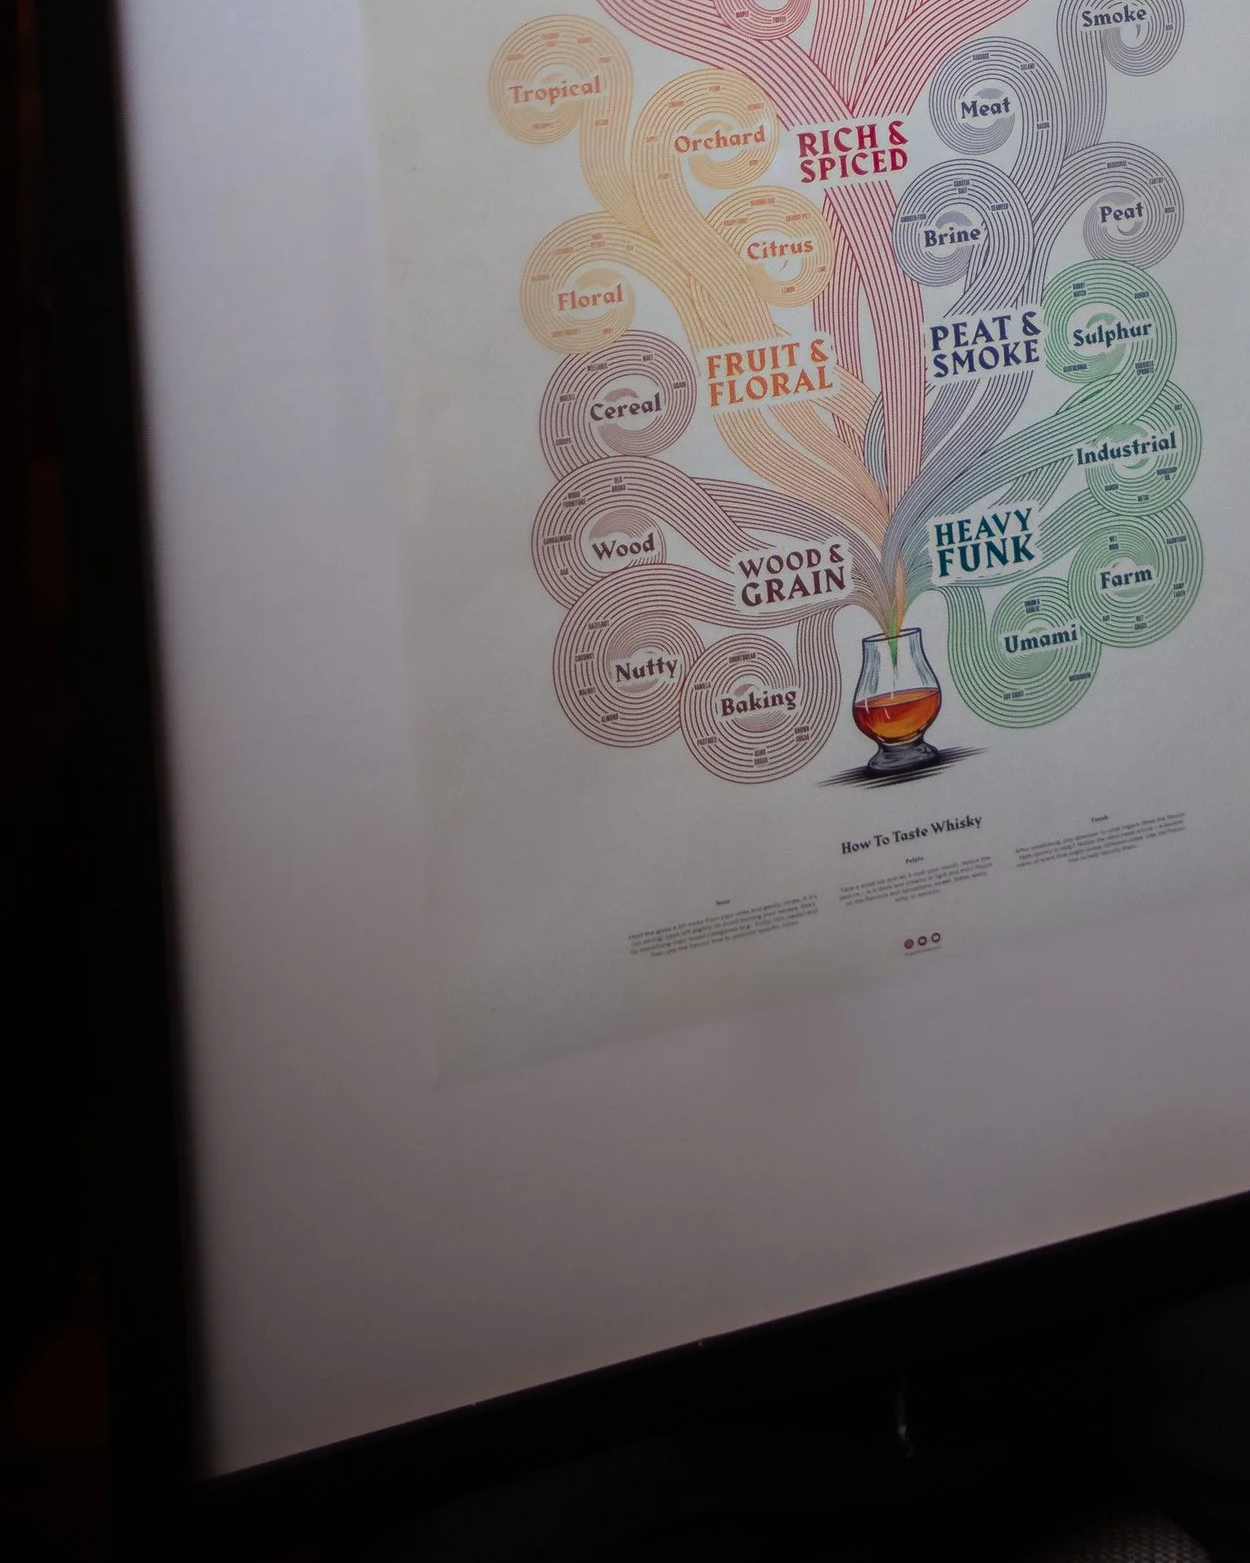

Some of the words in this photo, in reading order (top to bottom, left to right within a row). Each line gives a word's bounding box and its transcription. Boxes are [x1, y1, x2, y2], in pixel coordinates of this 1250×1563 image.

[1081, 3, 1148, 28] Smoke
[508, 75, 601, 106] Tropical
[961, 96, 1011, 119] Meat
[674, 125, 766, 153] Orchard
[797, 123, 879, 159] RICH
[888, 120, 909, 146] &
[800, 148, 909, 184] SPICED
[1100, 201, 1144, 223] Peat
[747, 240, 814, 260] Citrus
[924, 226, 981, 248] Brine
[558, 283, 624, 311] Floral
[930, 315, 1011, 351] PEAT
[1021, 311, 1042, 336] &
[1072, 322, 1152, 348] Sulphur
[706, 342, 800, 379] FRUIT
[810, 338, 829, 363] &
[933, 339, 1039, 378] SMOKE
[709, 365, 833, 407] FLORAL
[590, 392, 662, 421] Cereal
[1076, 431, 1177, 465] Industrial
[934, 508, 1033, 547] HEAVY
[592, 532, 655, 560] Wood
[937, 533, 1036, 577] FUNK
[737, 545, 822, 579] WOOD
[829, 544, 845, 564] &
[741, 566, 846, 606] GRAIN
[1100, 568, 1153, 590] Farm
[1003, 624, 1078, 653] Umami
[615, 657, 678, 682] Nutty
[721, 691, 797, 717] Baking
[841, 840, 871, 854] How
[873, 834, 890, 847] To
[892, 827, 929, 843] Taste
[931, 814, 982, 835] Whisky
